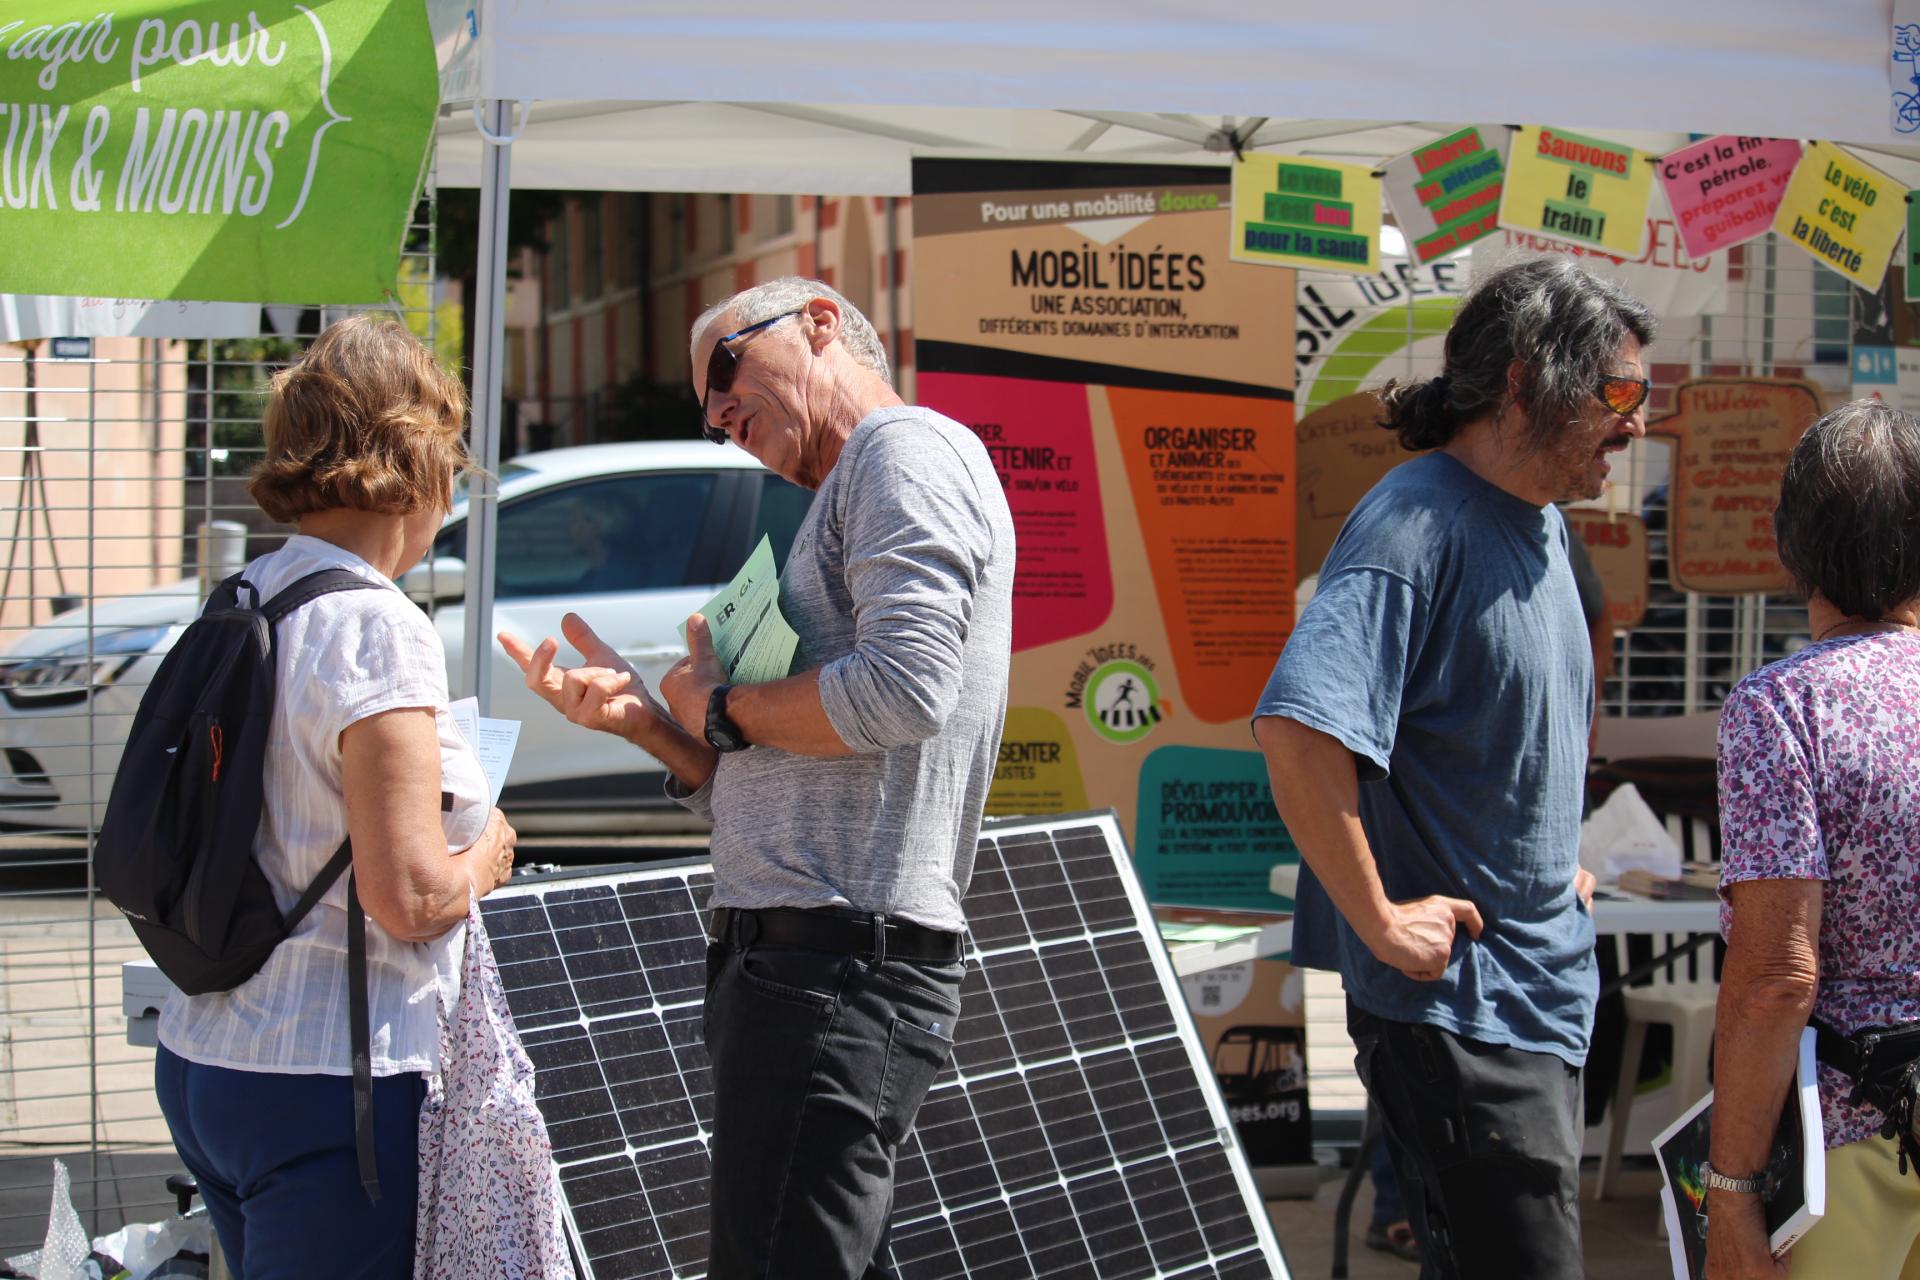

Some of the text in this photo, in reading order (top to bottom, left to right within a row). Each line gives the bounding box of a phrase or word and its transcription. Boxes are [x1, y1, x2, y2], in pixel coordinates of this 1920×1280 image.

[7, 10, 286, 92] agir pour
[70, 105, 110, 213] &
[115, 106, 290, 216] MOINS
[1537, 129, 1628, 174] Sauvons
[1664, 153, 1711, 180] C'est
[1714, 145, 1734, 161] la
[1566, 173, 1588, 200] le
[1825, 160, 1877, 207] Le vélo
[981, 201, 1030, 223] Pour
[1032, 202, 1071, 221] une
[1073, 192, 1156, 218] mobilité
[1314, 202, 1351, 228] bon
[1681, 180, 1767, 228] préparez
[1818, 198, 1857, 233] c'est
[1542, 205, 1594, 237] train
[1244, 230, 1369, 263] pour la santé
[1791, 215, 1863, 273] la liberté
[1031, 295, 1188, 320] UNE ASSOCIATION,
[979, 314, 1240, 340] DIFFÉRENTS DOMAINES D'INTERVENTION
[1144, 427, 1256, 452] ORGANISER
[1057, 456, 1073, 471] ET
[1150, 453, 1165, 468] ET
[1168, 452, 1225, 468] ANIMER
[1161, 778, 1258, 800] DÉVELOPPER
